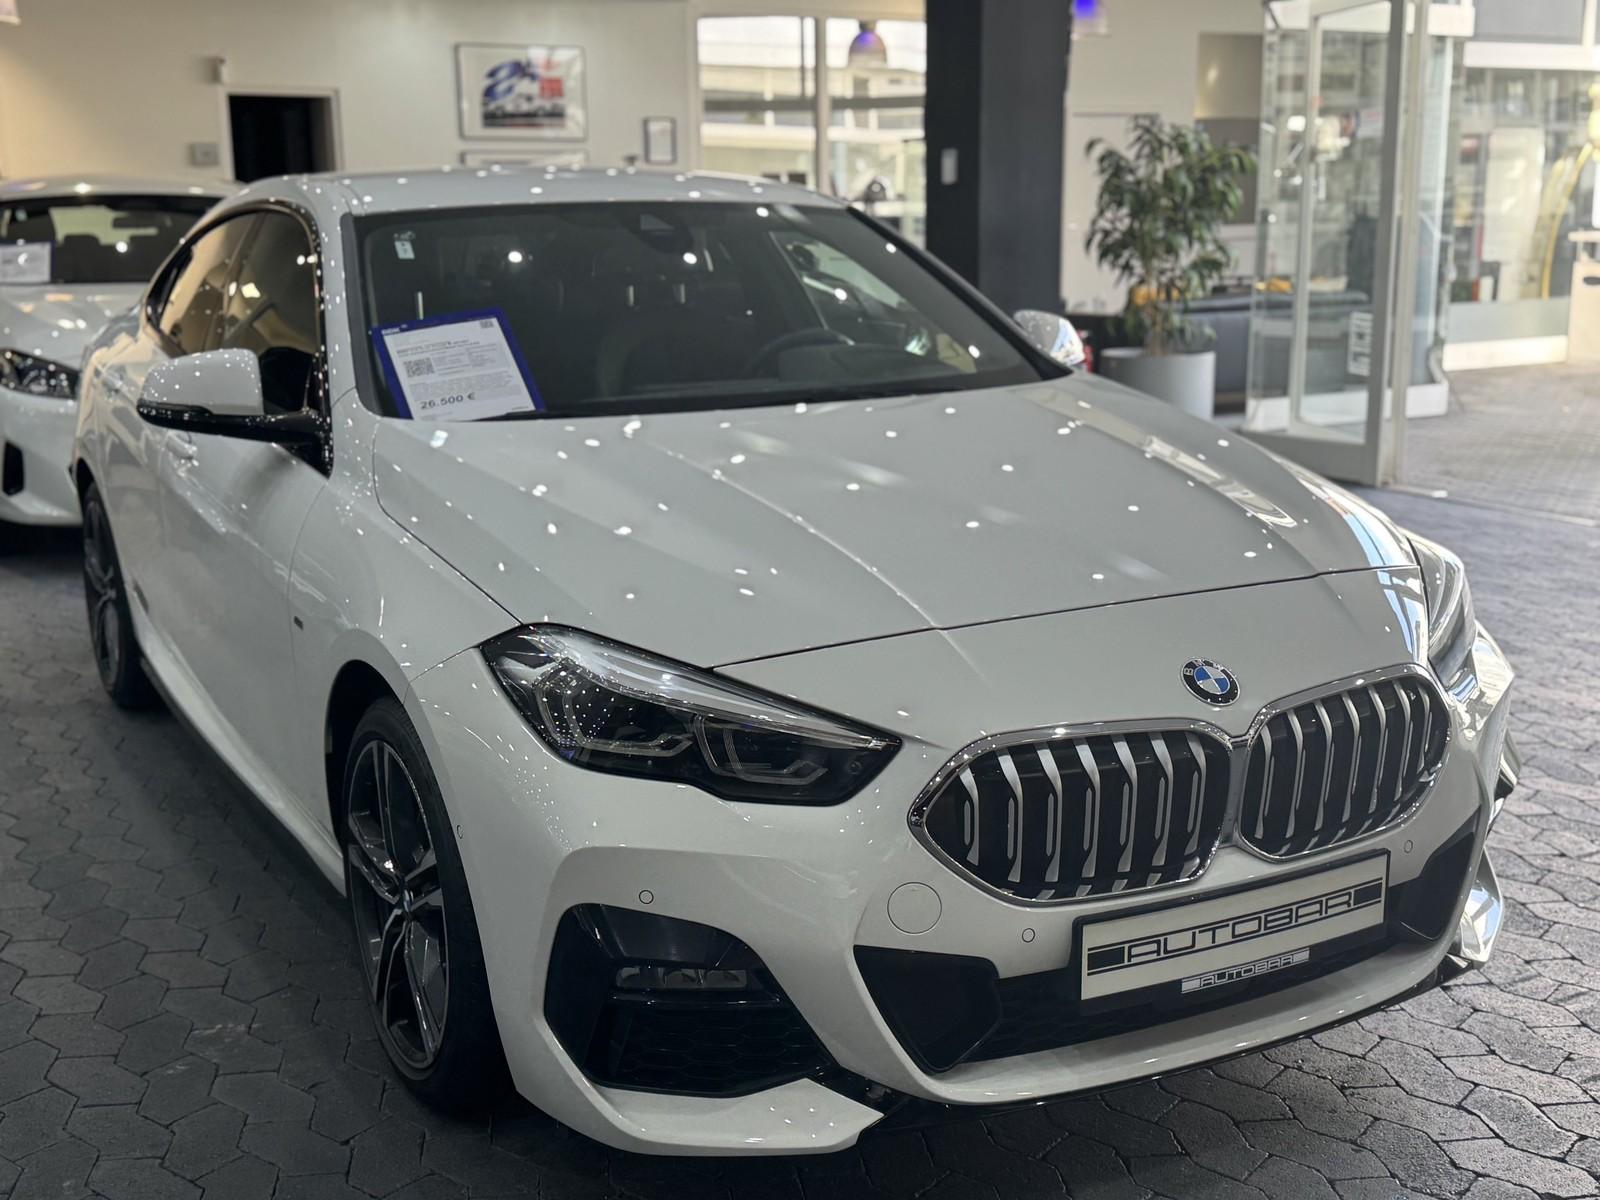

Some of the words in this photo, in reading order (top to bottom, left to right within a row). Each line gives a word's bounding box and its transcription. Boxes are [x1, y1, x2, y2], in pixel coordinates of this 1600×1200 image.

[420, 395, 464, 409] 26.500
[467, 392, 476, 401] €
[1127, 891, 1352, 963] AUTOBAR
[1199, 955, 1295, 987] AUTOBAR
